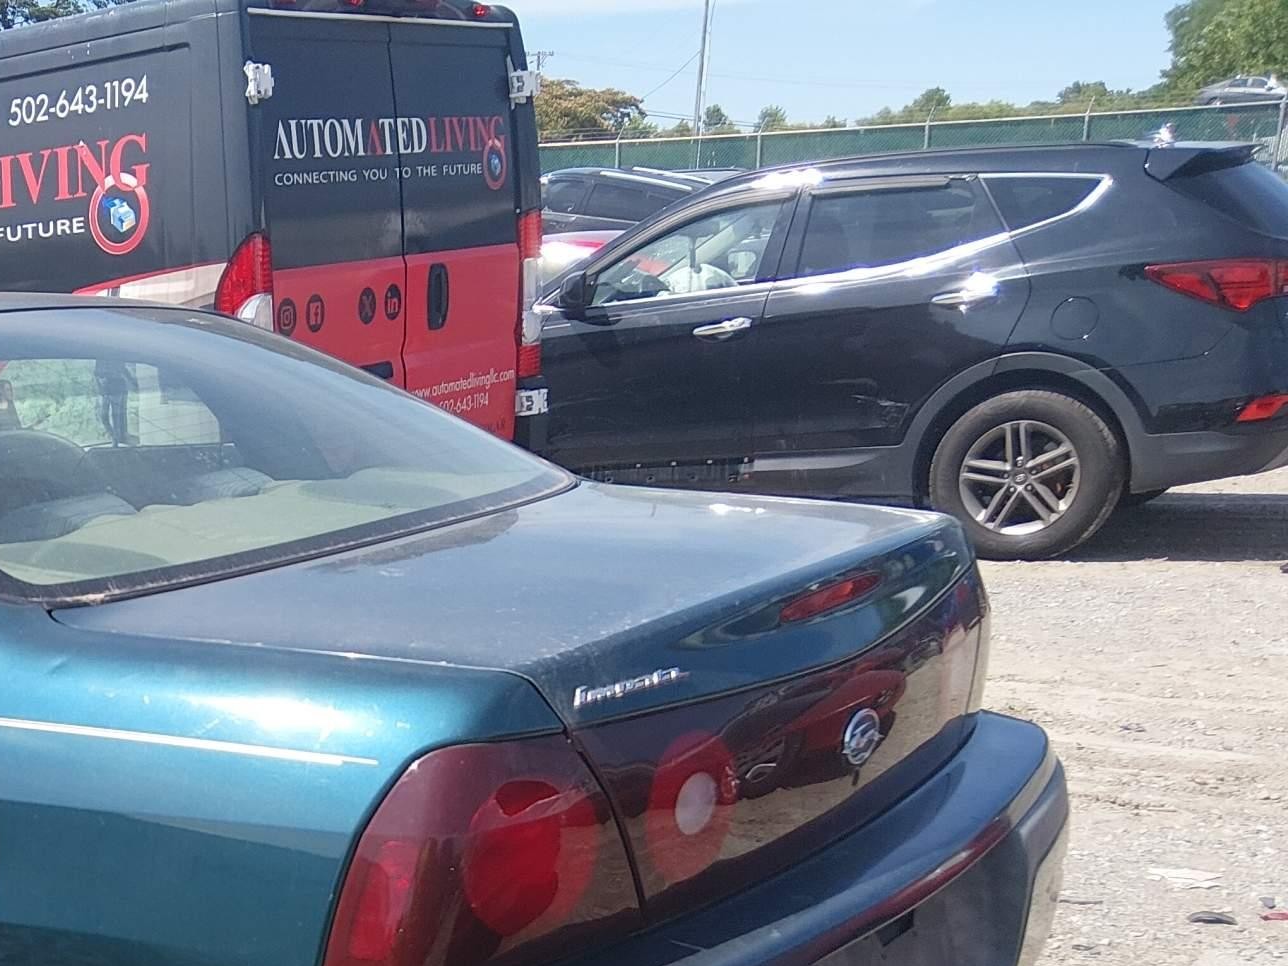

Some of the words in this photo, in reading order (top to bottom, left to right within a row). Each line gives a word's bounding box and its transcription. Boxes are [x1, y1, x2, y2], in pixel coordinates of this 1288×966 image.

[8, 74, 149, 127] 502-643-1194
[273, 117, 427, 159] AUTOMATED
[428, 115, 505, 152] LIVING
[274, 169, 357, 186] CONNECTING
[362, 167, 388, 181] YOU
[394, 166, 411, 179] TO
[416, 165, 438, 177] THE
[442, 162, 483, 176] FUTURE
